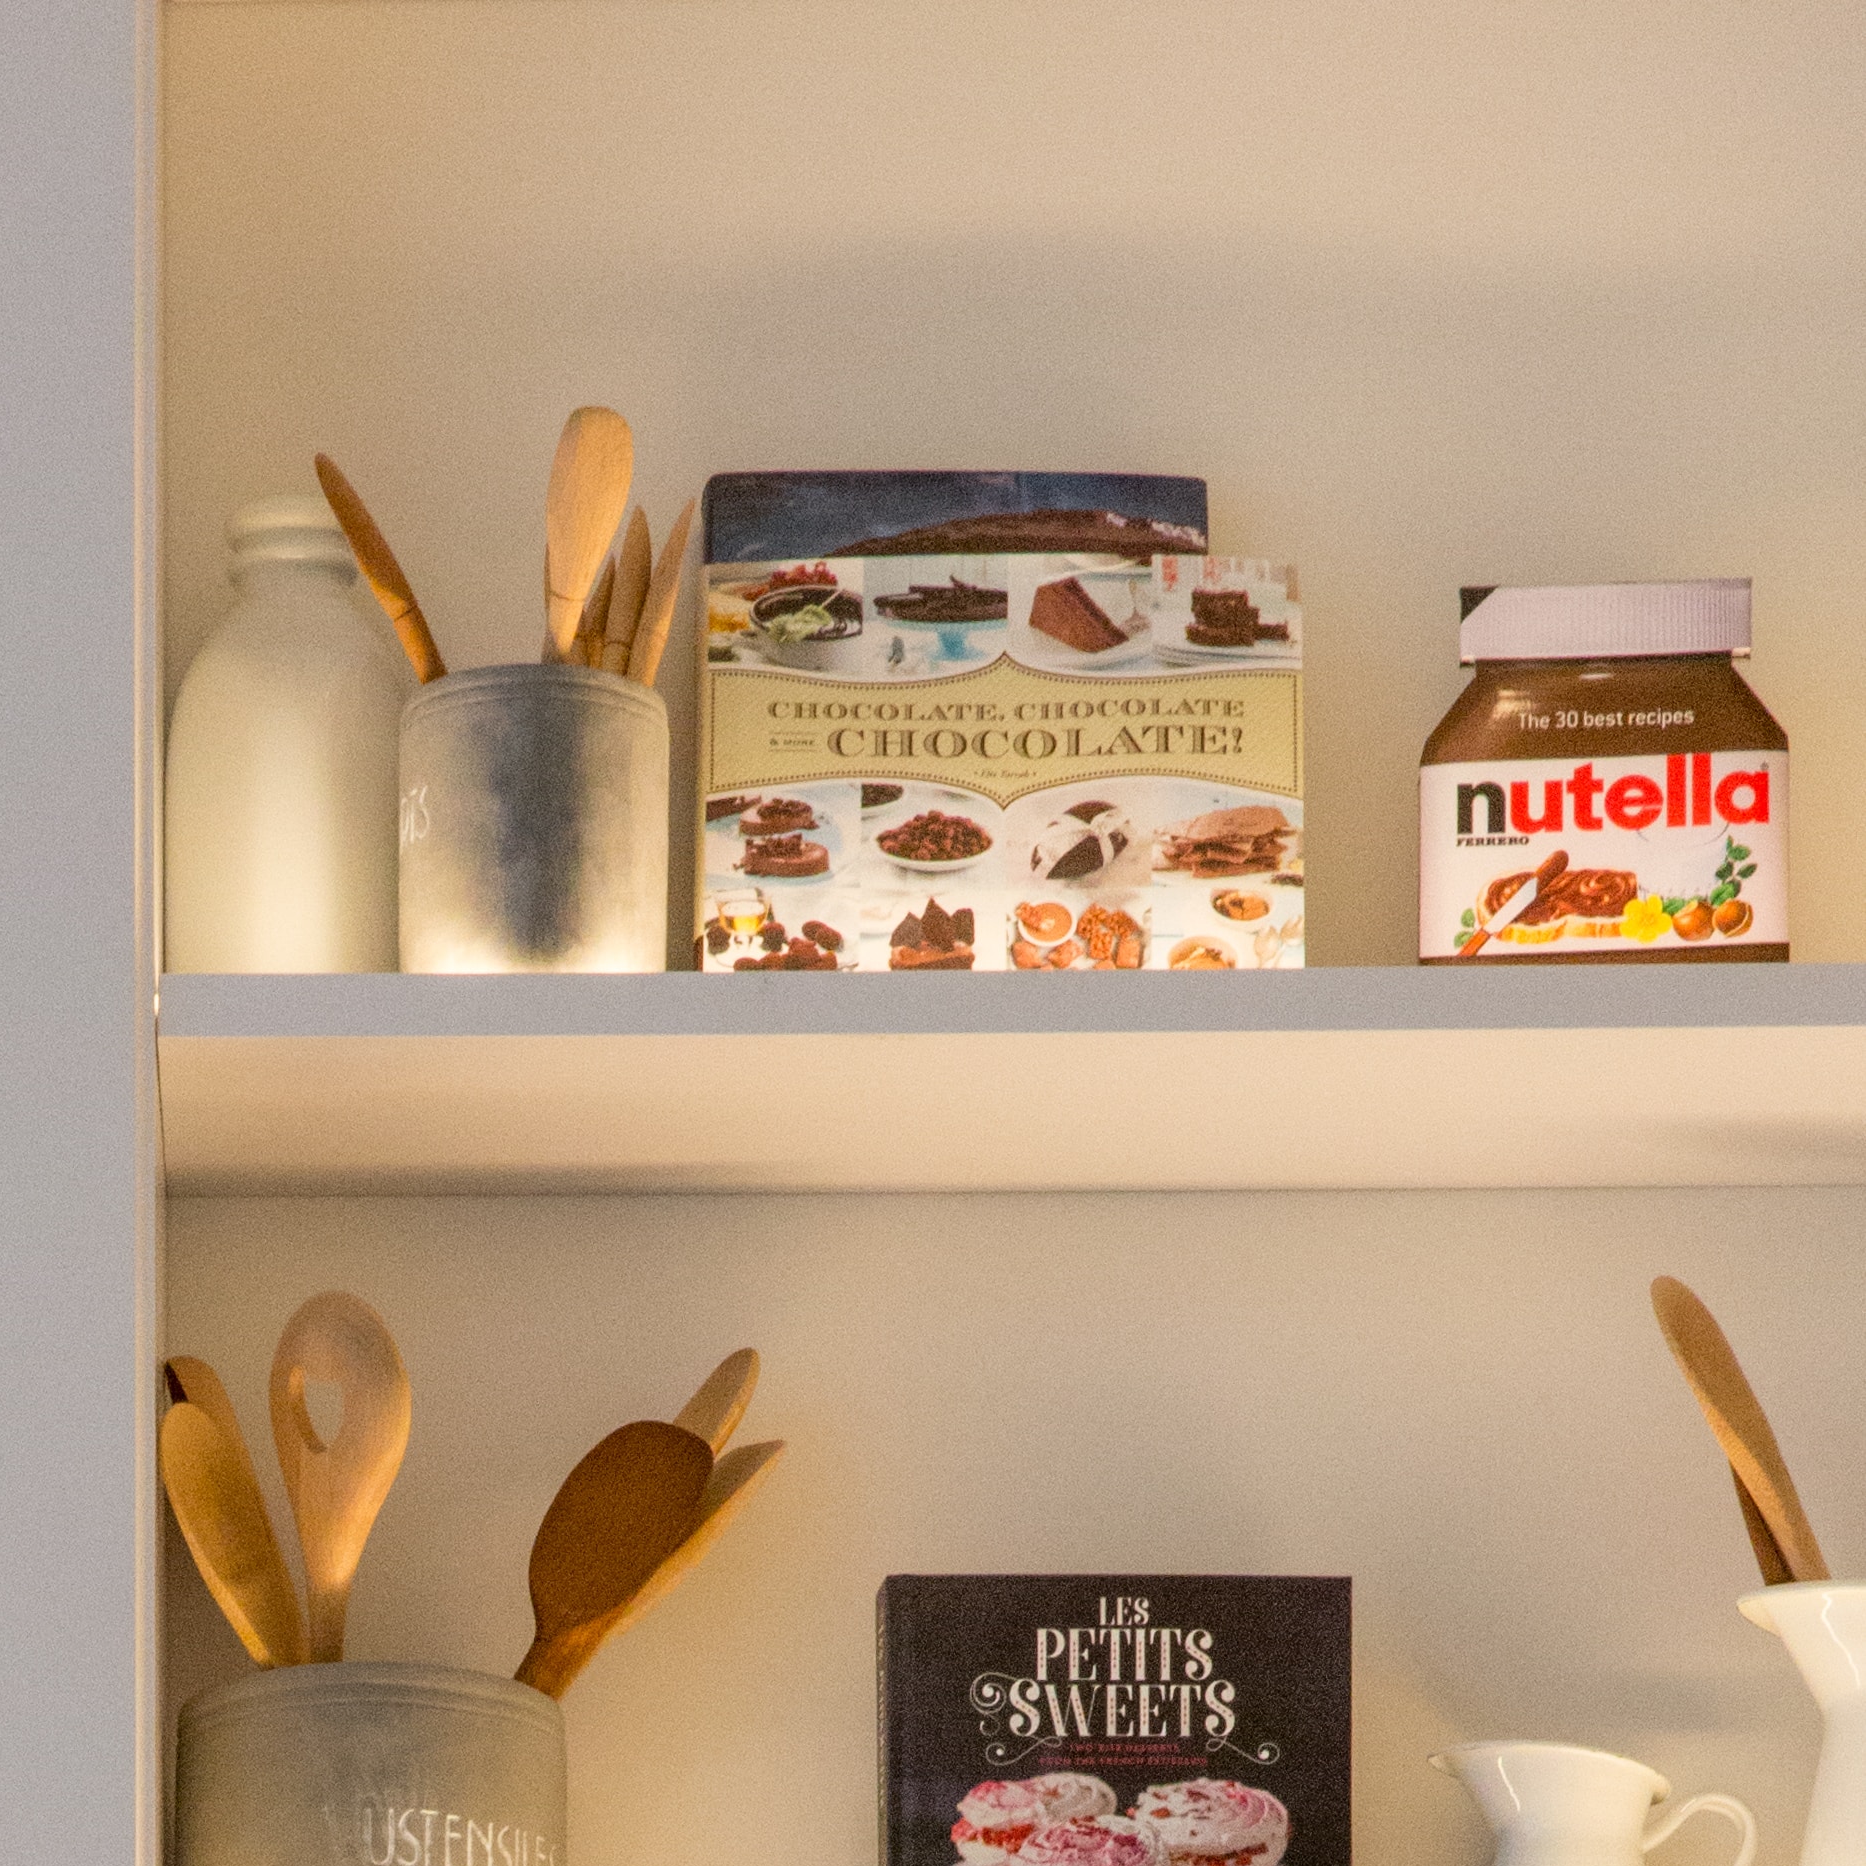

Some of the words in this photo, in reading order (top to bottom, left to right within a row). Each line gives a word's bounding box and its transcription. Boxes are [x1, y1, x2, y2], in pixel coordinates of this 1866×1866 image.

[768, 702, 1005, 722] CHOCOLATE,
[1014, 699, 1244, 720] CHOCOLATE
[1519, 711, 1551, 729] The
[1554, 710, 1579, 729] 30
[1583, 710, 1624, 728] best
[1628, 706, 1695, 730] recipes
[827, 725, 1243, 759] CHOCOLATE!
[1456, 753, 1769, 836] nutella
[1100, 1596, 1149, 1627] LES
[1036, 1627, 1214, 1681] PETITS
[1009, 1679, 1236, 1738] SWEETS
